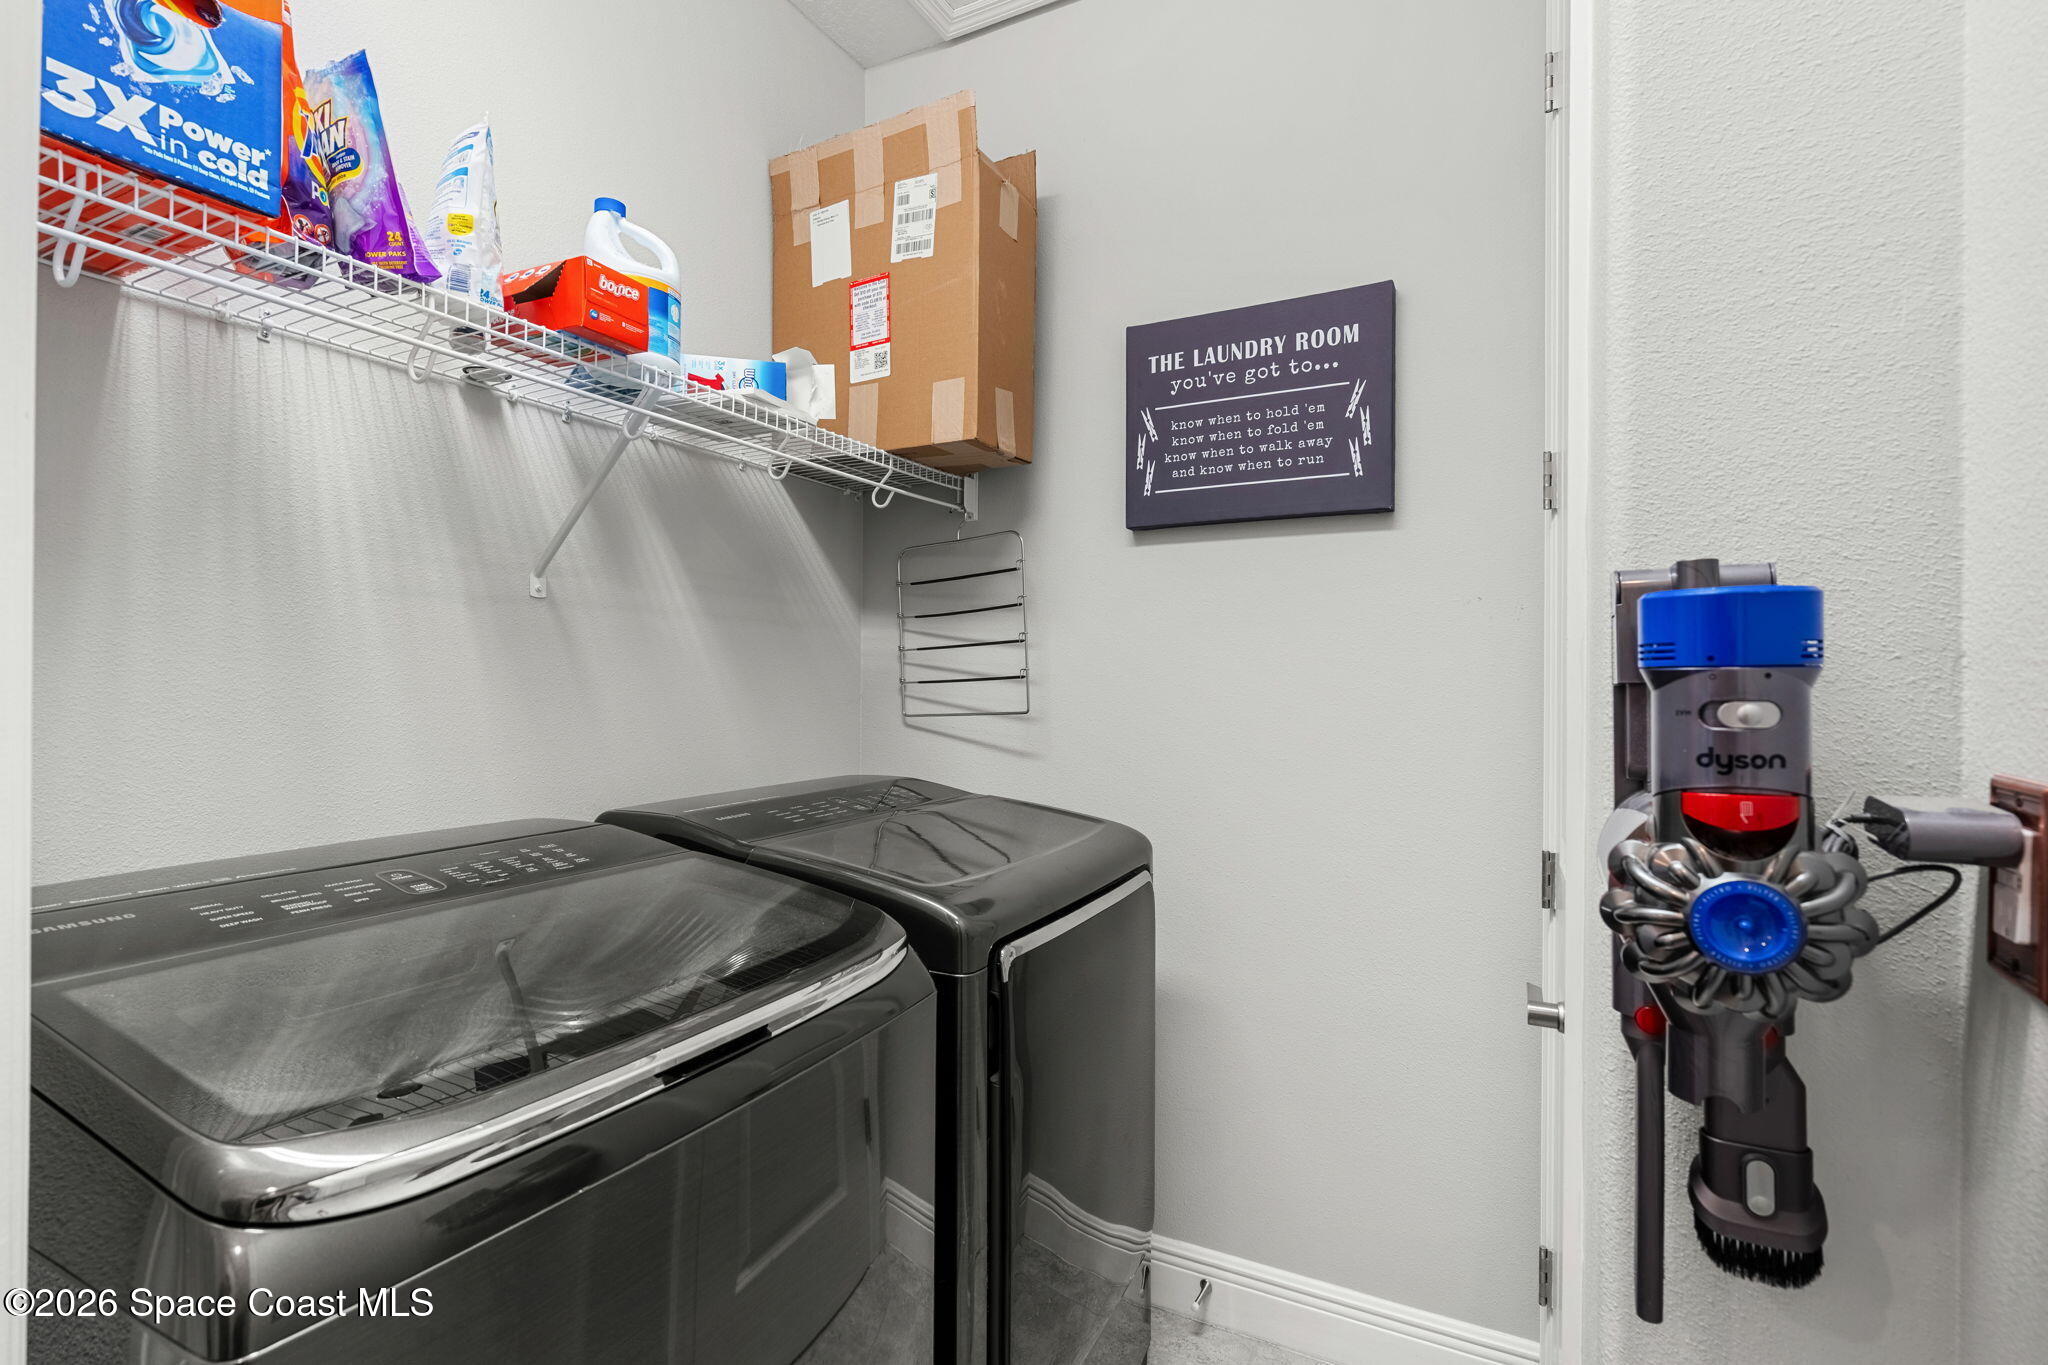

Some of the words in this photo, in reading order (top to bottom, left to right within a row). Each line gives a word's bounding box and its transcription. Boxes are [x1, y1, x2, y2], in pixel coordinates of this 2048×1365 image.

[41, 56, 158, 147] 3X
[160, 130, 188, 159] in
[198, 150, 269, 191] cold
[386, 231, 402, 242] 24
[480, 297, 496, 306] OWER
[599, 273, 640, 302] bounce
[1148, 351, 1185, 374] THE
[1193, 335, 1286, 368] LAUNDRY
[1295, 323, 1359, 351] ROOM
[1170, 370, 1236, 395] you've
[1244, 362, 1281, 385] got
[1289, 358, 1339, 374] to...
[1170, 417, 1204, 431] know
[1208, 413, 1242, 427] when
[1246, 410, 1261, 421] to
[1266, 404, 1300, 418] hold
[1304, 403, 1325, 414] 'em
[1171, 433, 1204, 447] know
[1208, 429, 1242, 442] when
[1247, 427, 1262, 437] to
[1267, 421, 1298, 435] fold
[1303, 420, 1324, 431] 'em
[1164, 450, 1197, 463] know
[1201, 446, 1235, 459] when
[1239, 444, 1254, 454] to
[1259, 439, 1293, 452] walk
[1298, 436, 1333, 450] away
[1172, 466, 1195, 479] and
[1200, 462, 1233, 475] know
[1238, 459, 1273, 472] when
[1277, 457, 1292, 467] to
[1297, 454, 1325, 466] run
[1697, 747, 1786, 775] dyson
[31, 912, 136, 935] SAMSUNG
